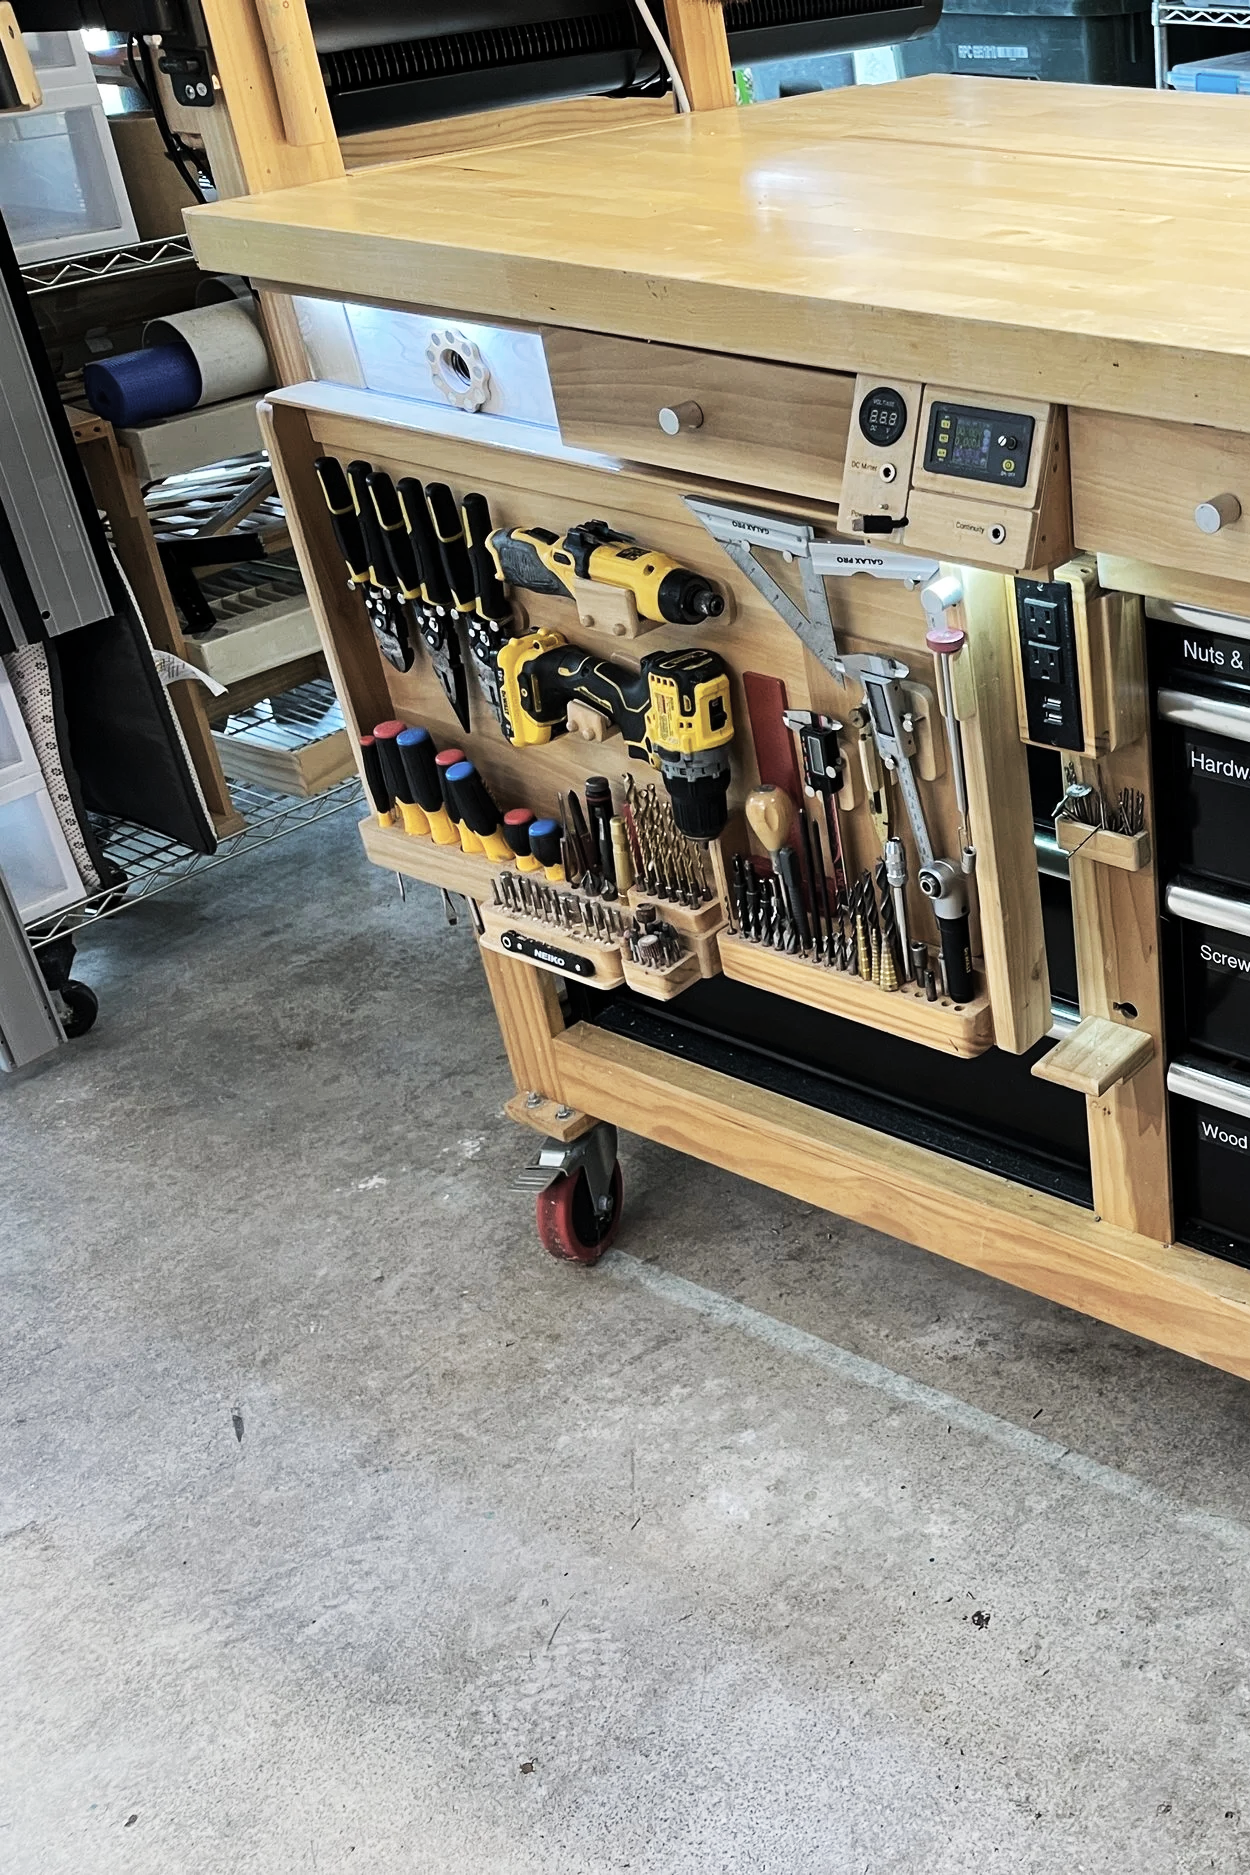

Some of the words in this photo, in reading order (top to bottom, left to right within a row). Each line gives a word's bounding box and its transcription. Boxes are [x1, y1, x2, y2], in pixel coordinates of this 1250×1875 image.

[746, 524, 770, 534] GALAX
[956, 521, 984, 534] Continuity
[1183, 640, 1225, 665] Nuts
[1231, 650, 1244, 670] &
[534, 949, 565, 966] NEIKO
[1201, 1122, 1248, 1149] Wood
